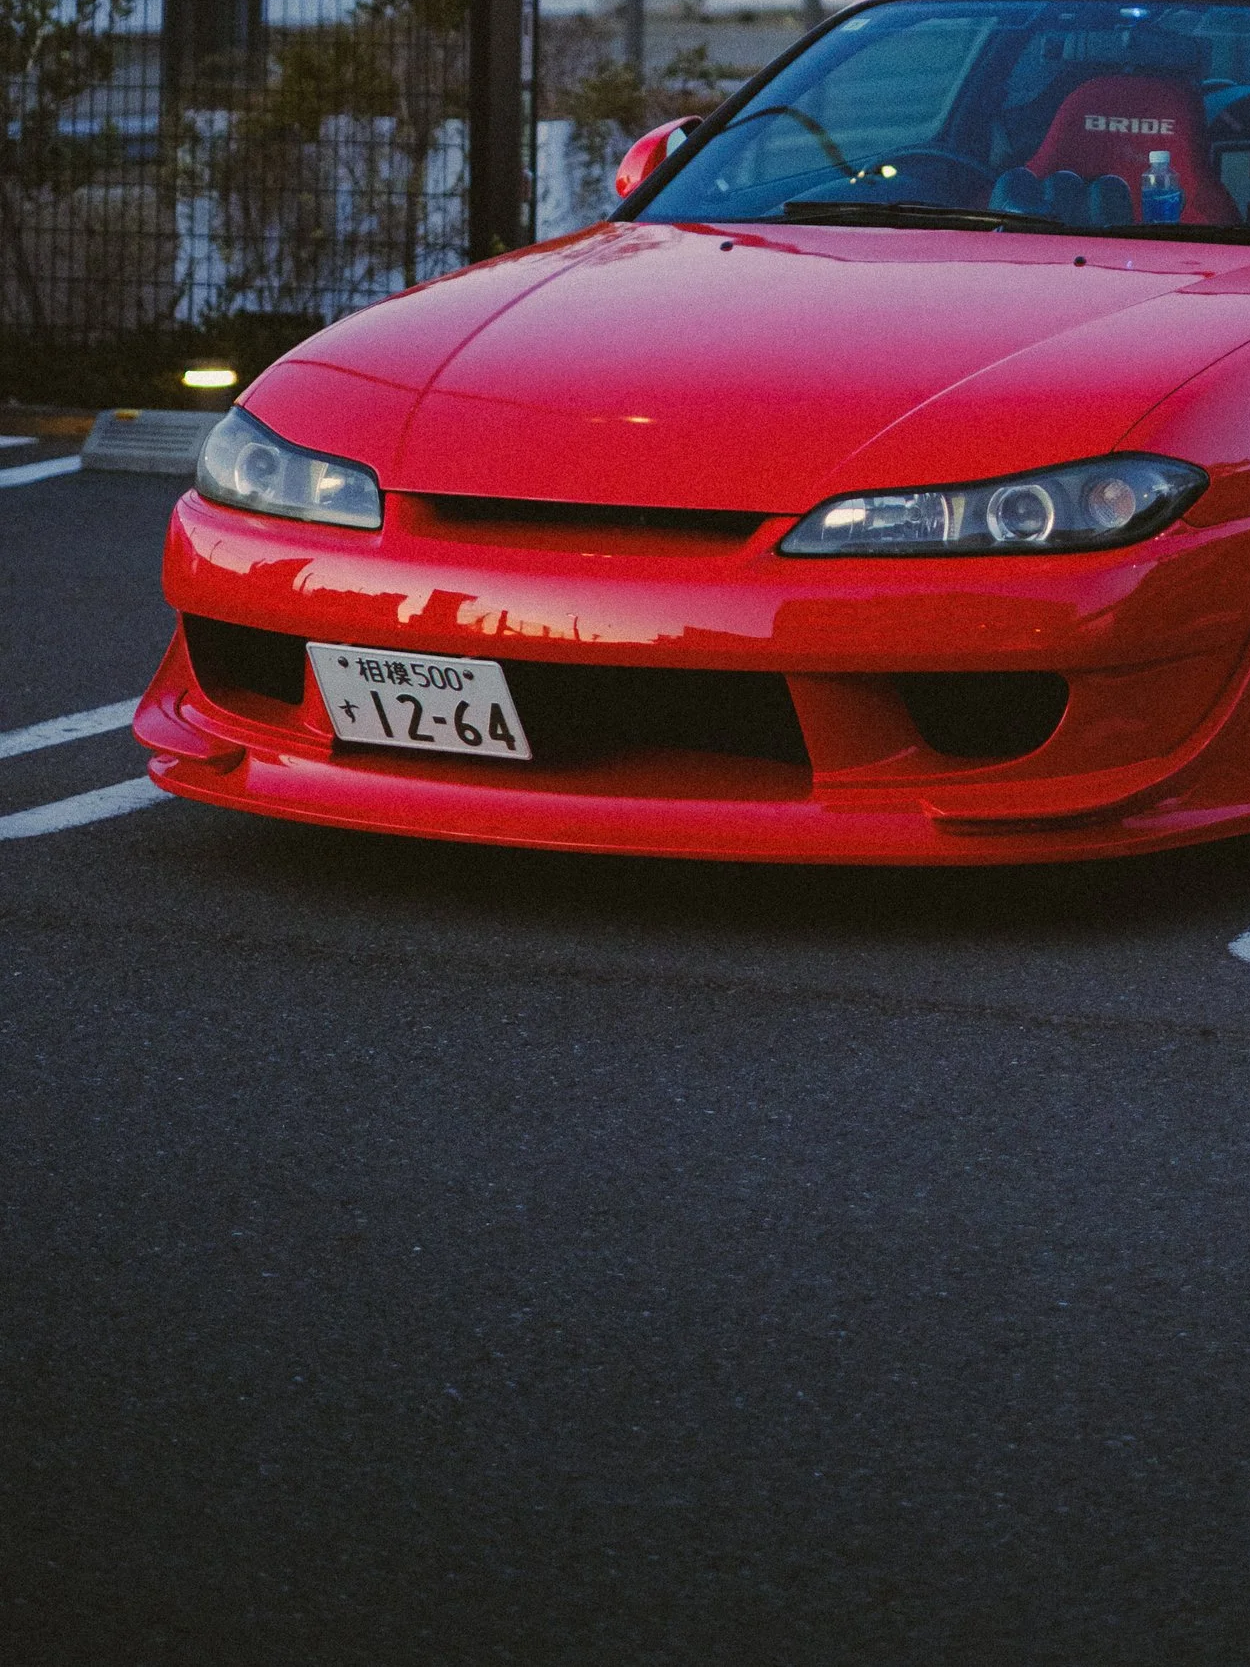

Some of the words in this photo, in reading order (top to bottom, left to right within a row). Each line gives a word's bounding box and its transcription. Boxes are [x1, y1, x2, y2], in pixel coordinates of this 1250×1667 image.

[1084, 115, 1175, 134] BRIDE
[338, 698, 360, 724] す
[370, 690, 517, 751] 12-64
